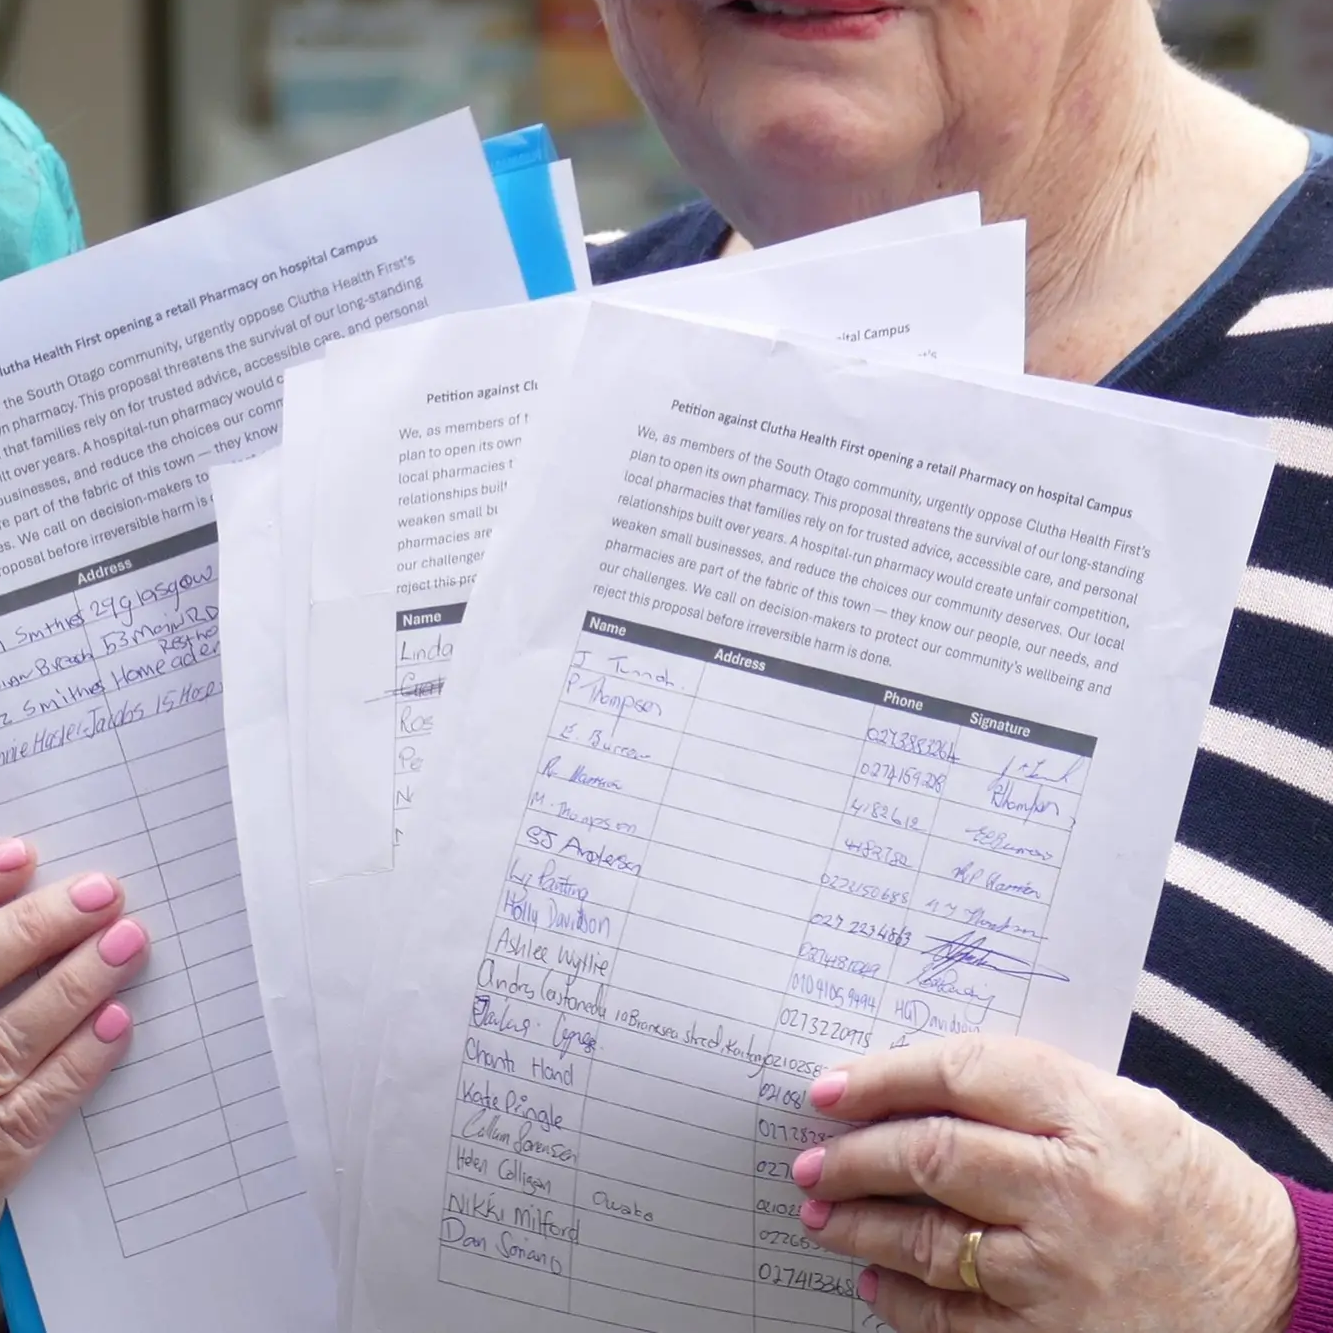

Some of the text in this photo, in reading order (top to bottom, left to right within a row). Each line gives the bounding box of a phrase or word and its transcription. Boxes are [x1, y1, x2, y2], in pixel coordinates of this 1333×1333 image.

[31, 342, 74, 366] Health
[74, 332, 103, 351] First
[103, 315, 155, 341] opening
[154, 311, 164, 323] a
[164, 296, 198, 319] retail
[198, 277, 259, 307] Pharmacy
[260, 270, 279, 284] on
[278, 249, 329, 278] hospital
[329, 234, 379, 259] Campus
[2, 394, 25, 410] the
[25, 379, 66, 402] South
[66, 366, 106, 388] Otago
[107, 339, 183, 373] community,
[184, 319, 236, 347] urgently
[237, 303, 286, 327] oppose
[286, 285, 331, 309] Clutha
[331, 269, 376, 293] Health
[375, 254, 417, 277] First's
[864, 323, 910, 340] Campus
[426, 387, 474, 405] Petition
[477, 382, 521, 400] against
[670, 398, 1134, 520] Petition against Clutha Health First opening a retail Pharmacy on hospital Campus
[637, 424, 1152, 560] We, as members of the South Otago community, urgently oppose Clutha Health First's
[77, 559, 132, 585] Address
[616, 494, 1130, 630] relationships built over years. A hospital-run pharmacy would create unfair competition,
[403, 610, 441, 625] Name
[590, 618, 626, 636] Name
[714, 648, 765, 672] Address
[883, 691, 923, 711] Phone
[970, 712, 1031, 737] Signature
